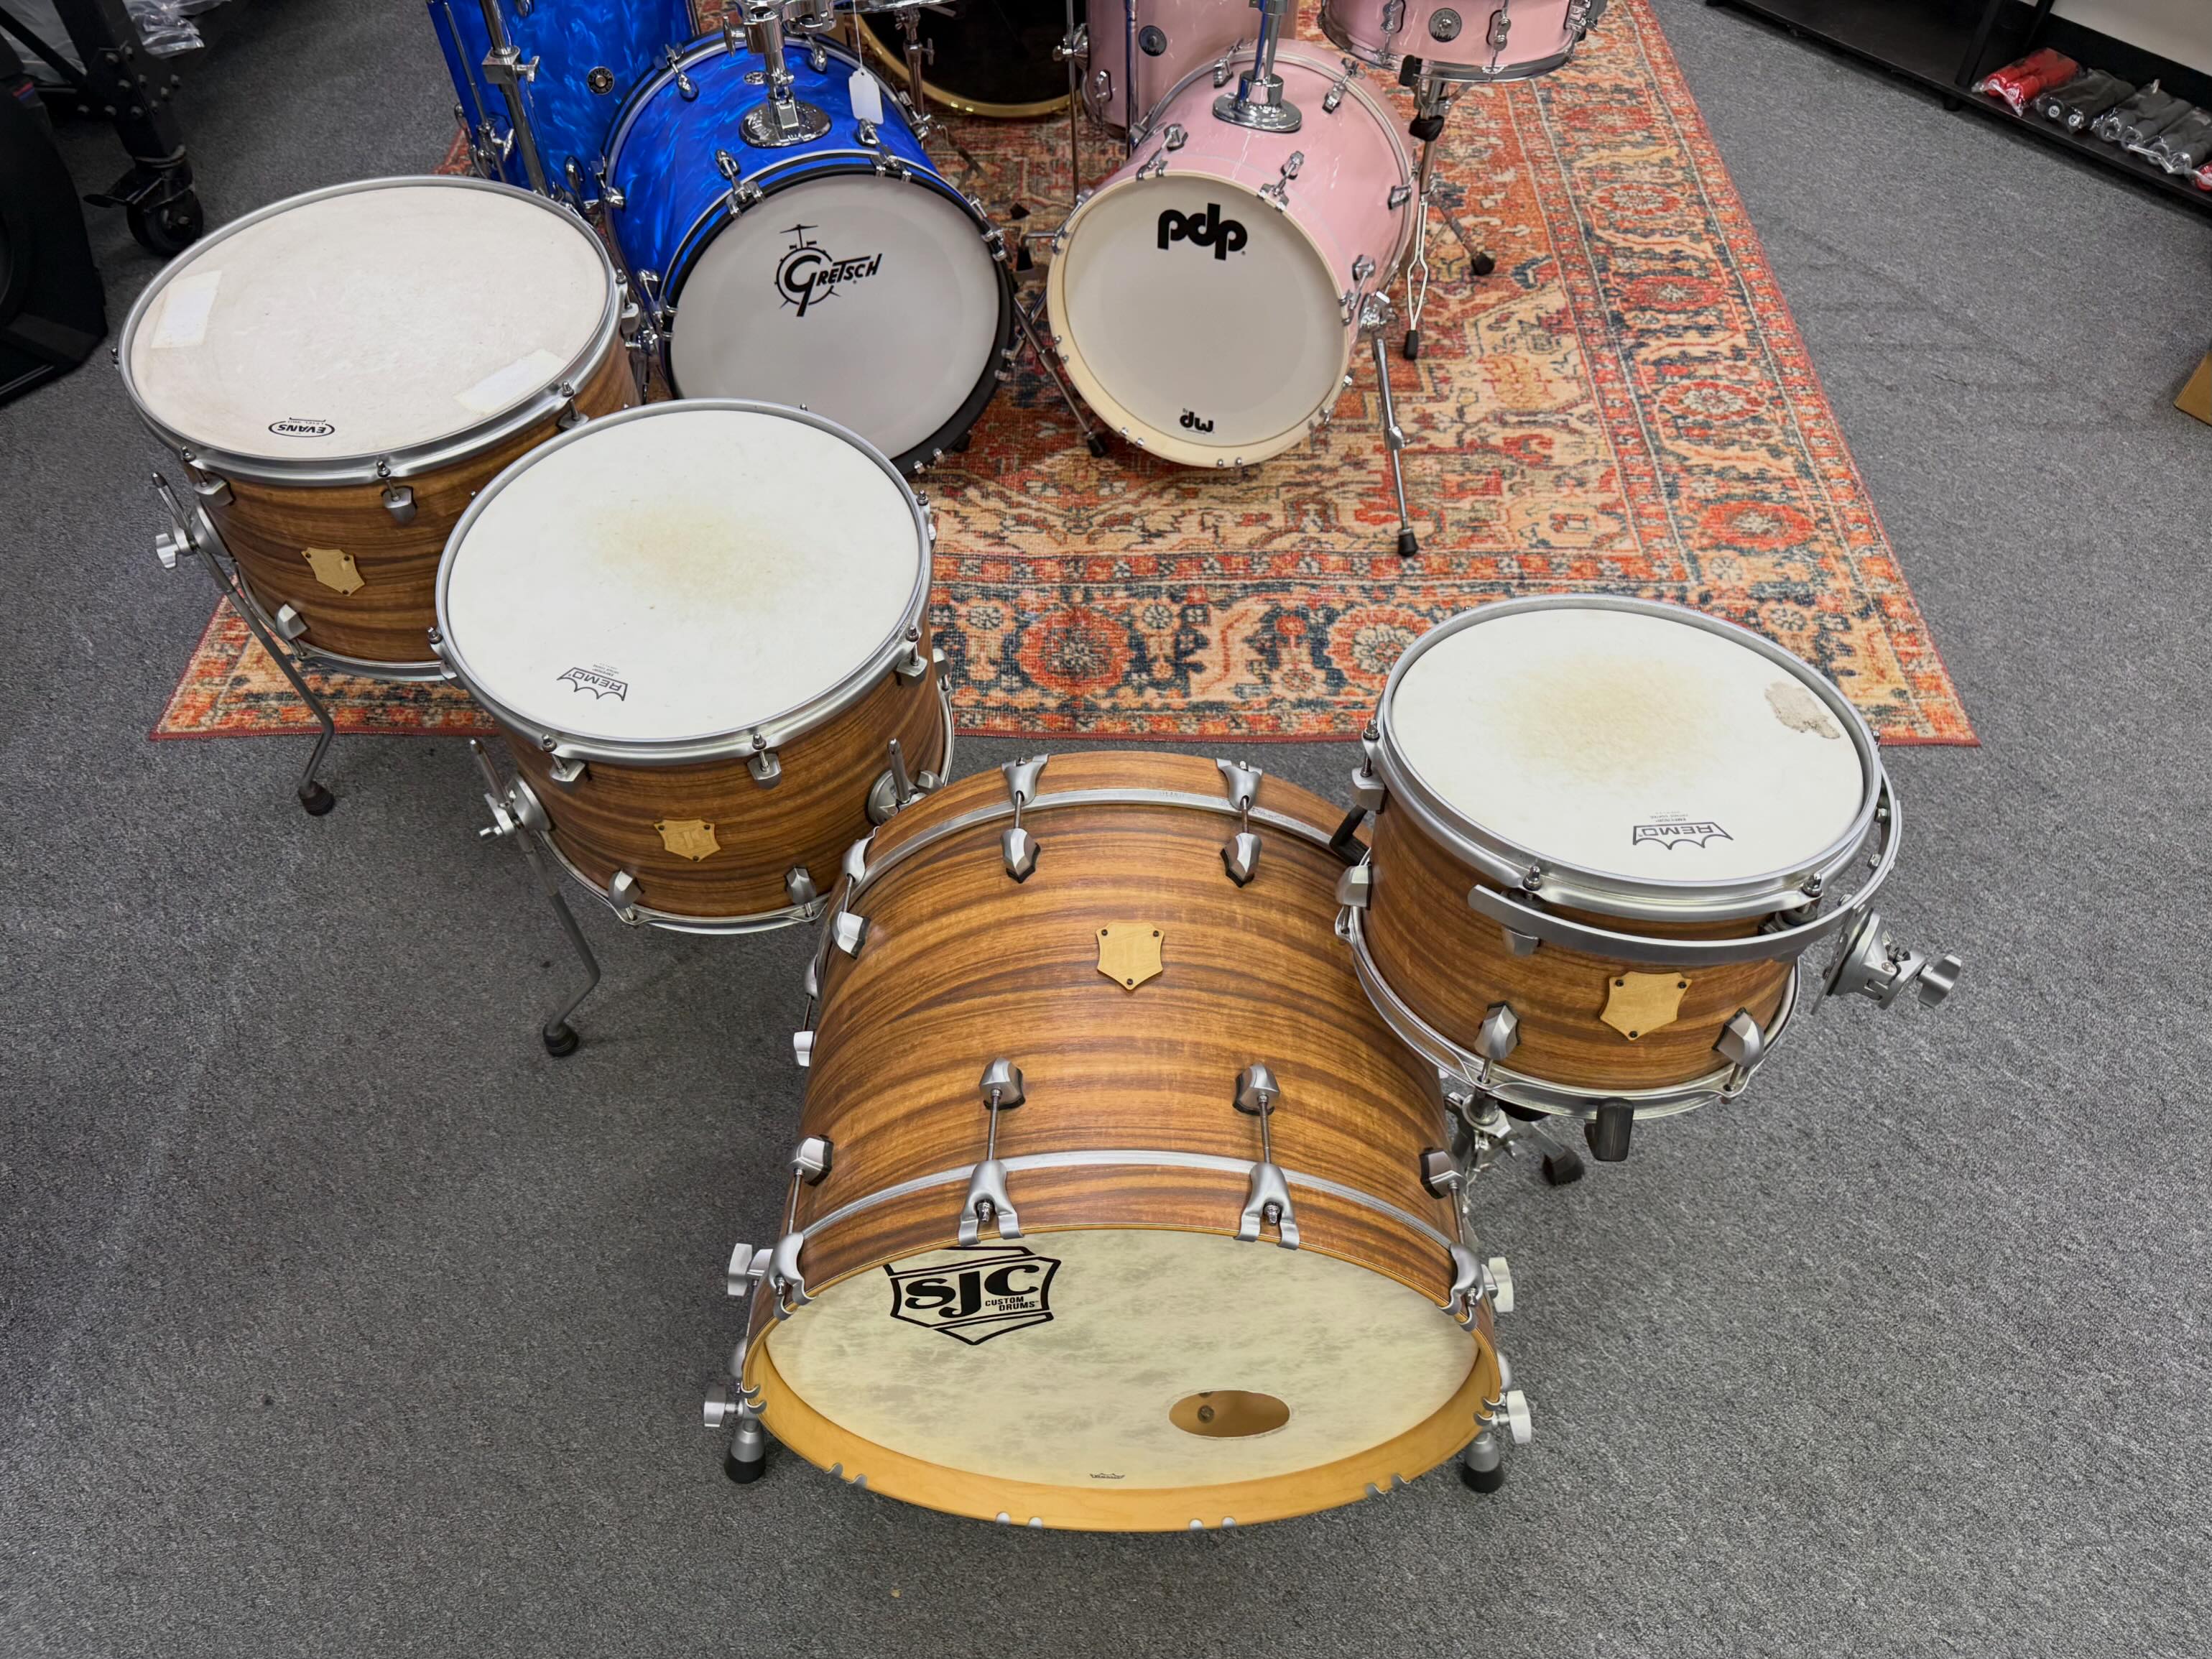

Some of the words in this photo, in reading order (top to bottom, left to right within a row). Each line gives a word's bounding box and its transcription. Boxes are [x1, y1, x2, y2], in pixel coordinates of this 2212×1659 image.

[1157, 203, 1248, 261] pdp
[277, 424, 327, 434] EVANS
[1180, 411, 1214, 433] dw
[572, 670, 622, 691] REMO
[1642, 825, 1714, 836] REMO
[904, 1264, 1040, 1318] SJC
[985, 1295, 1024, 1307] CUSTOM
[999, 1300, 1035, 1312] DRUMS
